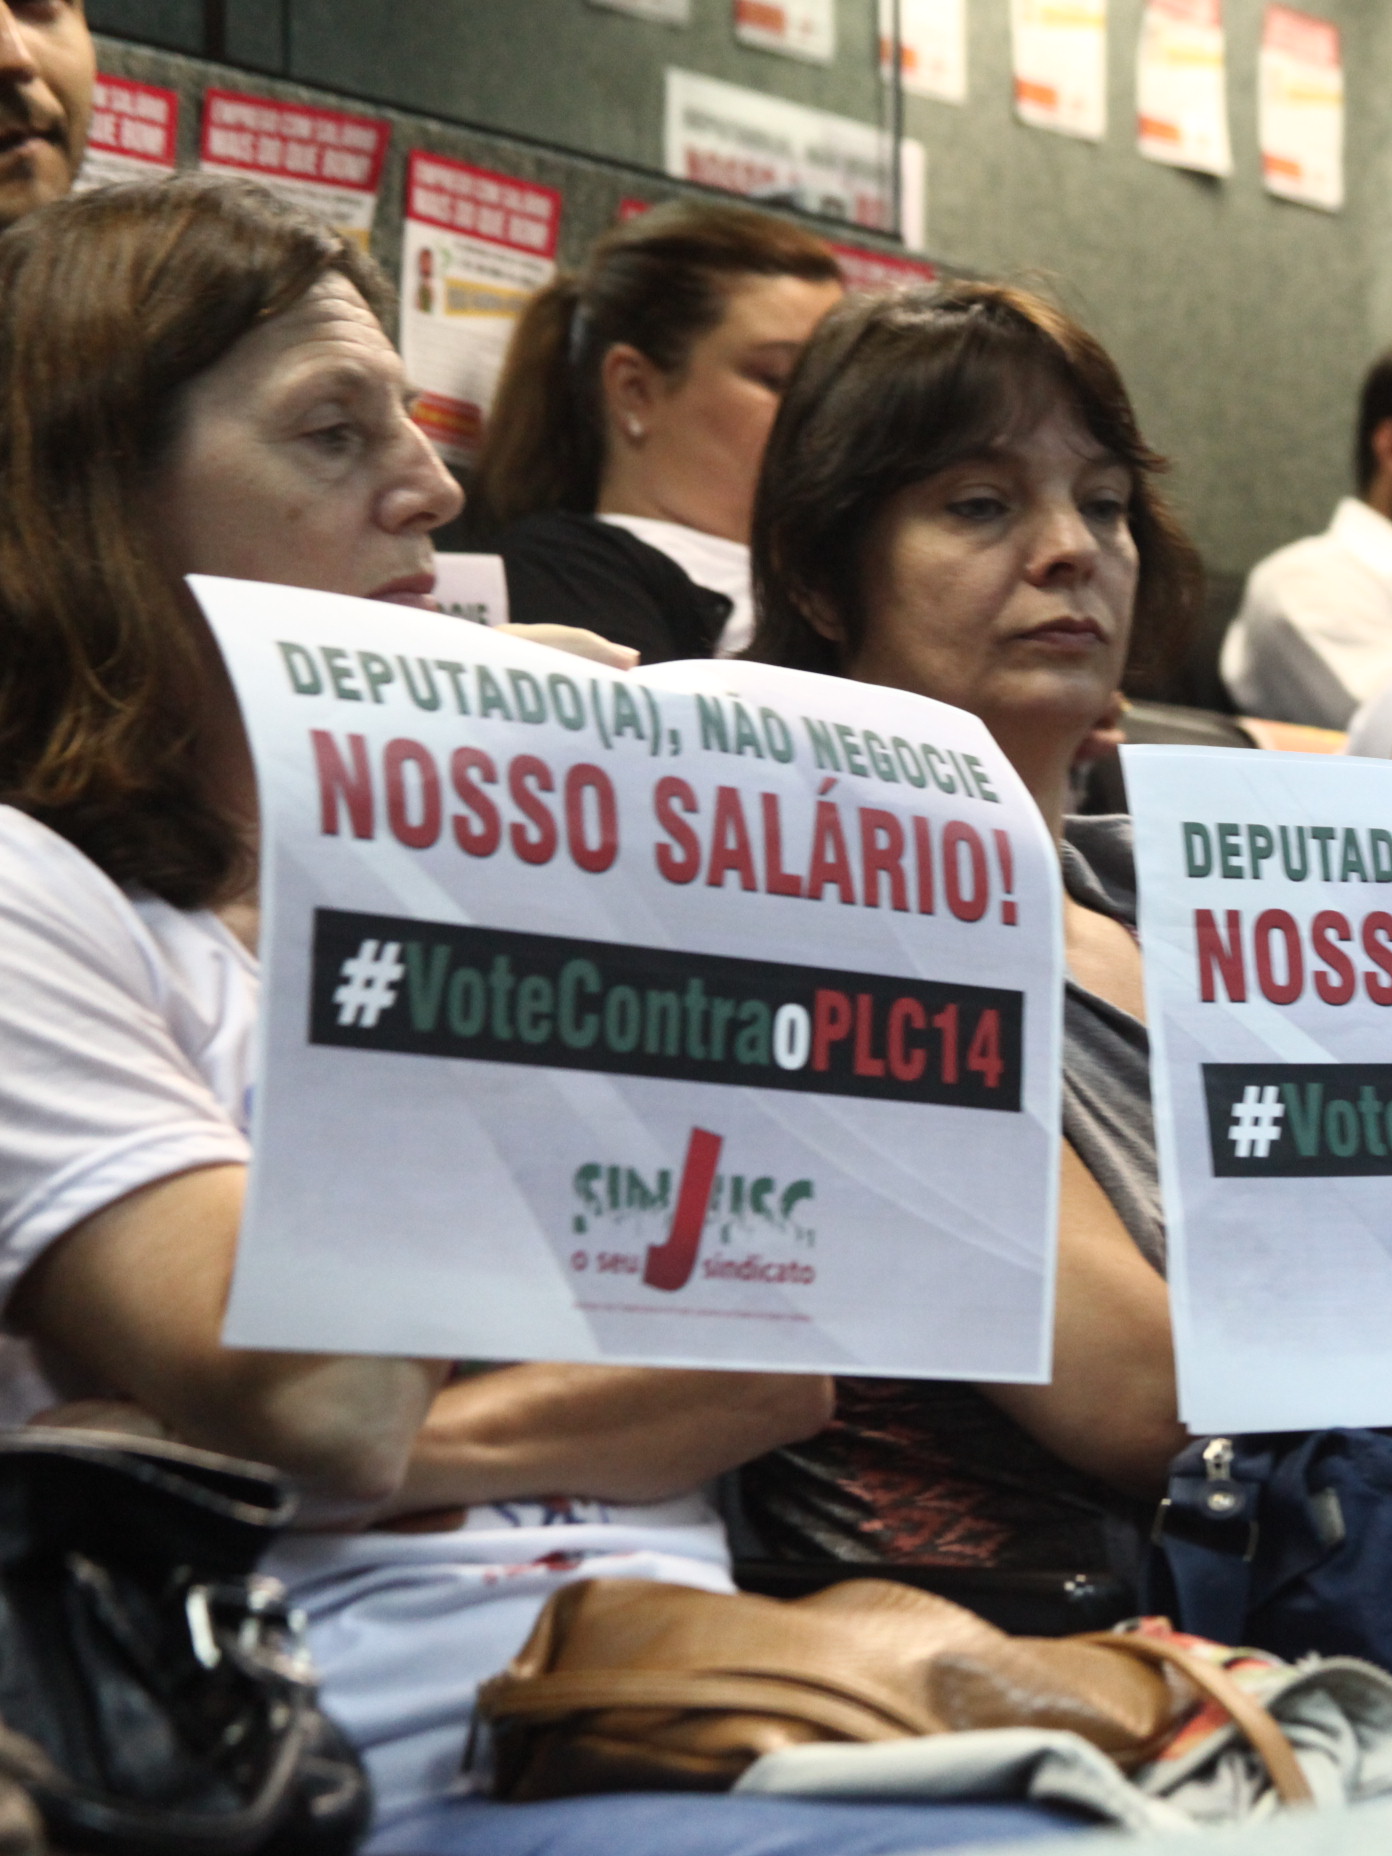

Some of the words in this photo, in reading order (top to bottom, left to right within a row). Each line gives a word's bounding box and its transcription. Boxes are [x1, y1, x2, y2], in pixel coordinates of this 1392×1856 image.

[276, 640, 681, 757] DEPUTADO(A),
[699, 691, 795, 764] NÃO
[802, 716, 1001, 803] NEGOCIE
[309, 729, 618, 873] NOSSO
[655, 776, 1018, 926] SALÁRIO!
[334, 939, 1003, 1088] #VoteContraoPLC14
[570, 1250, 588, 1272] o
[596, 1251, 640, 1274] seu
[702, 1250, 816, 1285] sindicato
